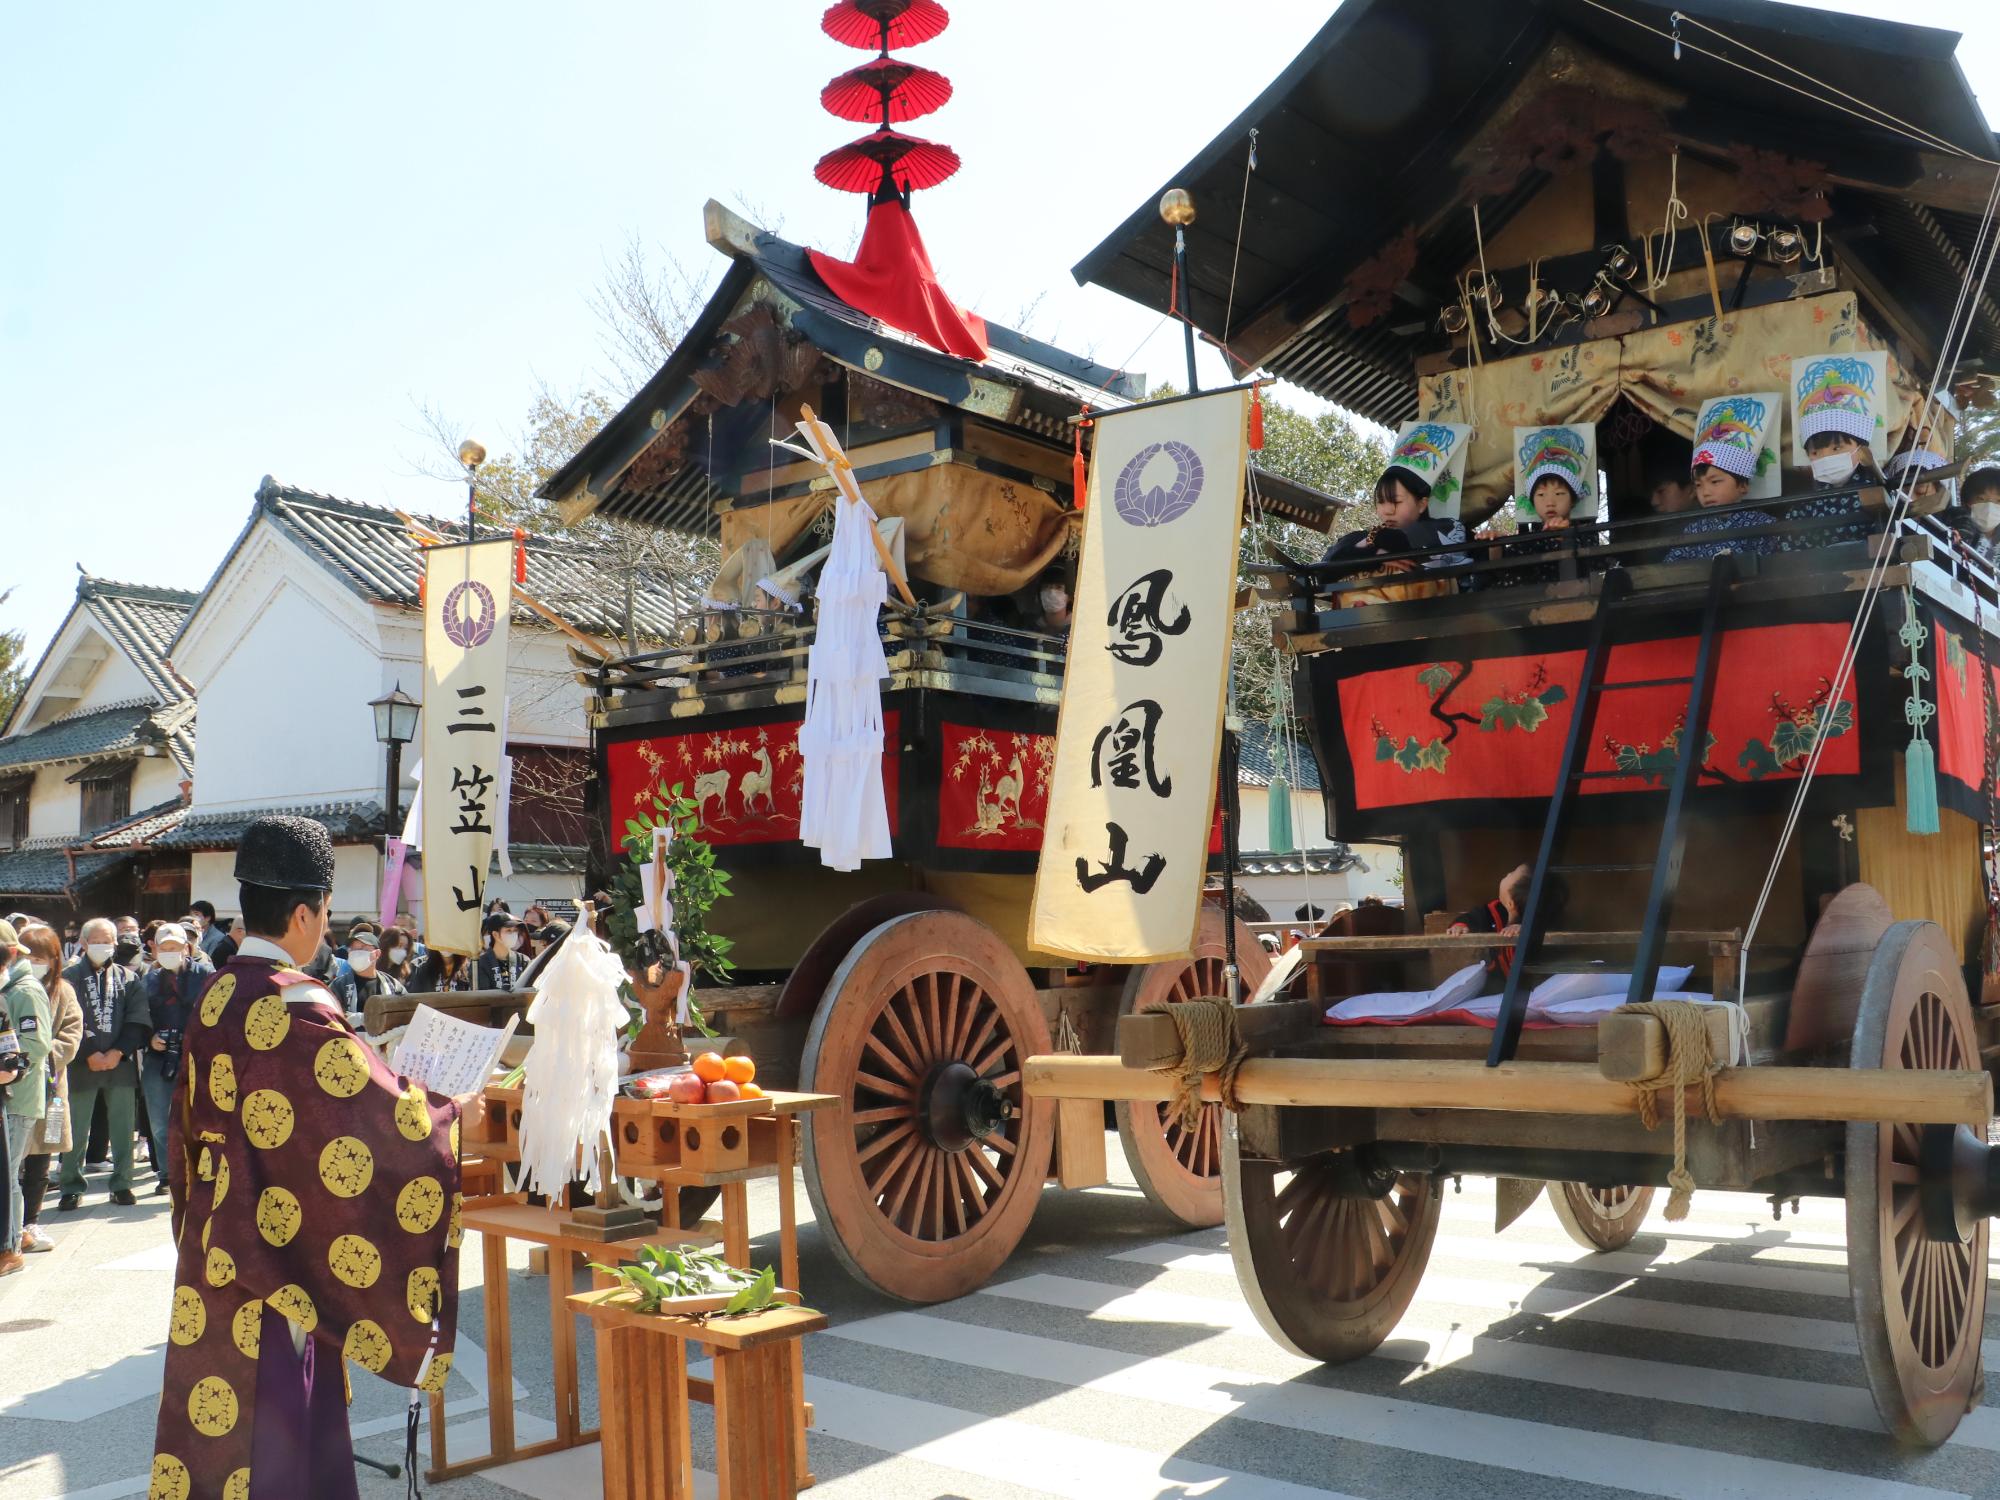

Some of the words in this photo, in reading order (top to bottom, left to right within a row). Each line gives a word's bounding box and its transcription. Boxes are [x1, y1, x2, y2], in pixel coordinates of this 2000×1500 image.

[447, 686, 496, 912] 三笠山
[1075, 569, 1191, 895] 鳳凰山
